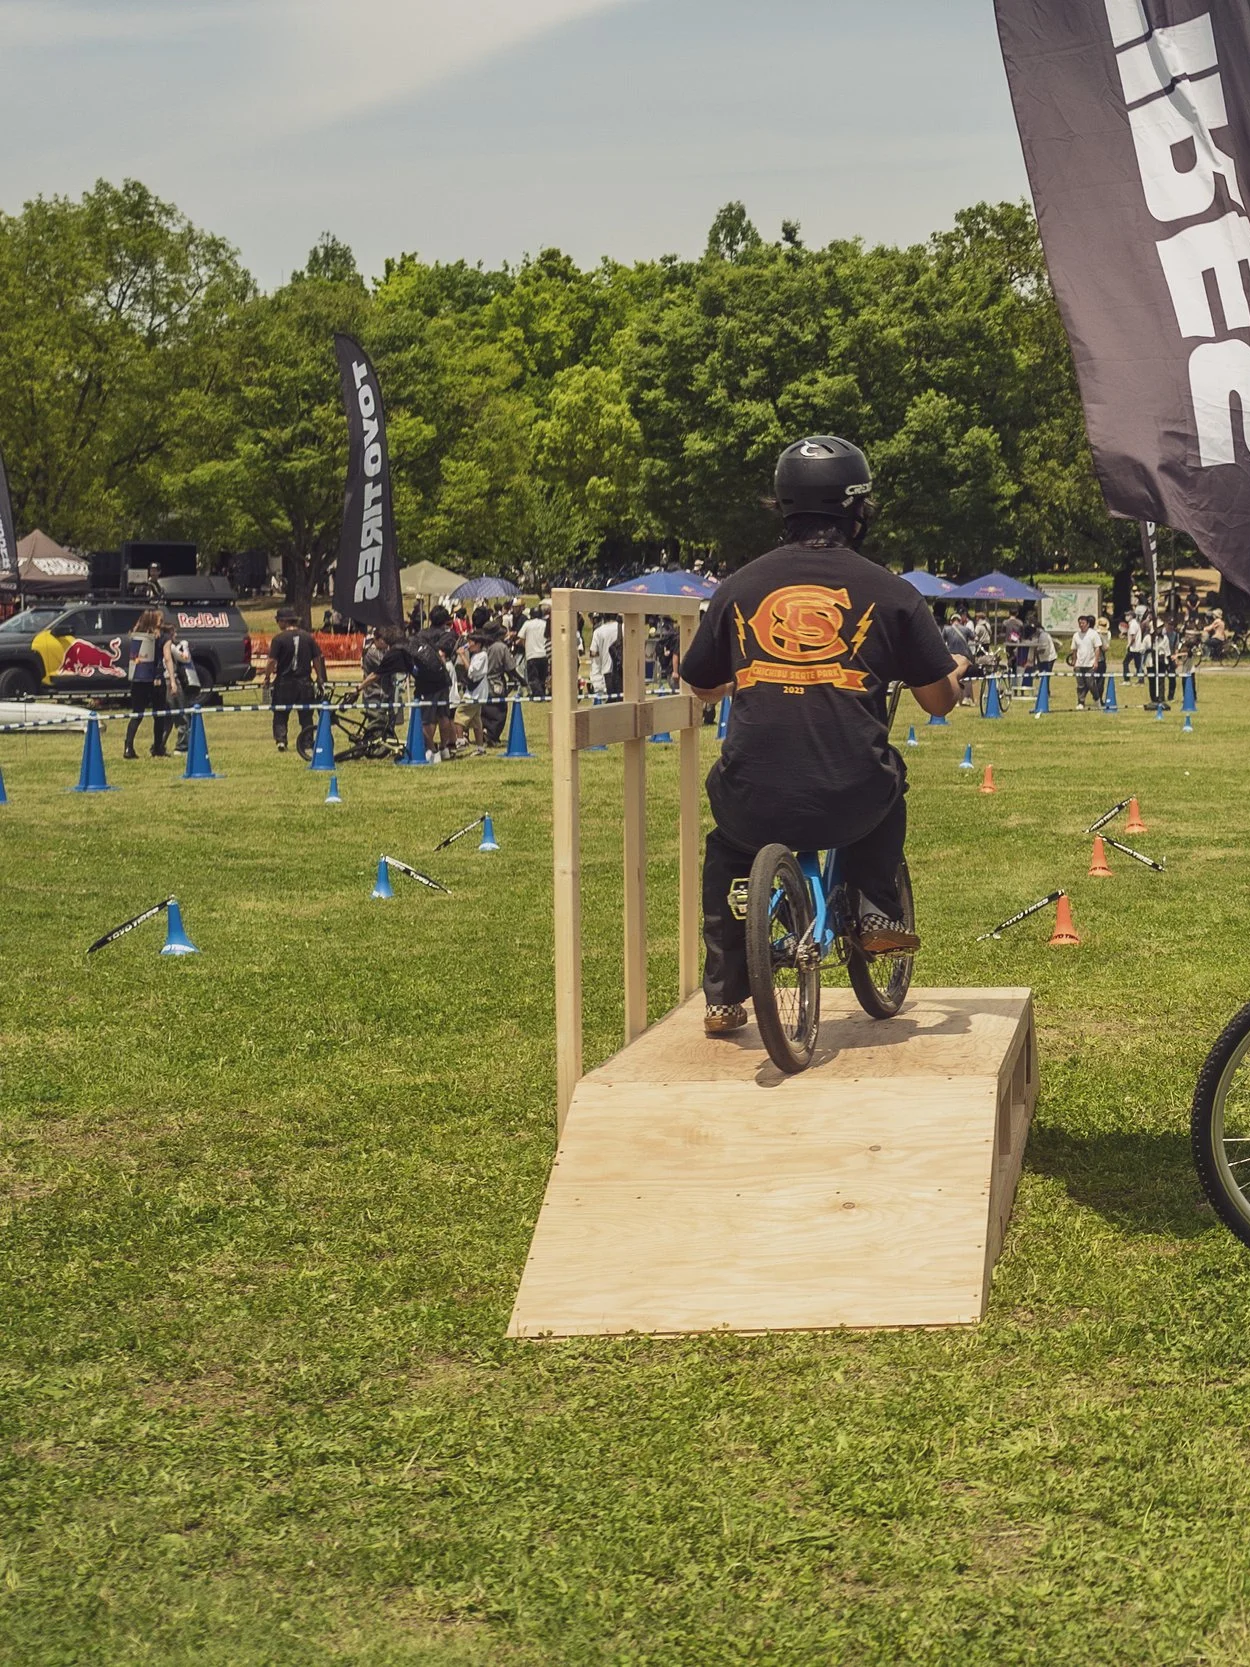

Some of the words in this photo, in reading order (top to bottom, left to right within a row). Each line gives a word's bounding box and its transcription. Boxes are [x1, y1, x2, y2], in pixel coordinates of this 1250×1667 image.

[178, 612, 204, 628] Red
[204, 612, 229, 628] Bull
[783, 686, 805, 695] 2023
